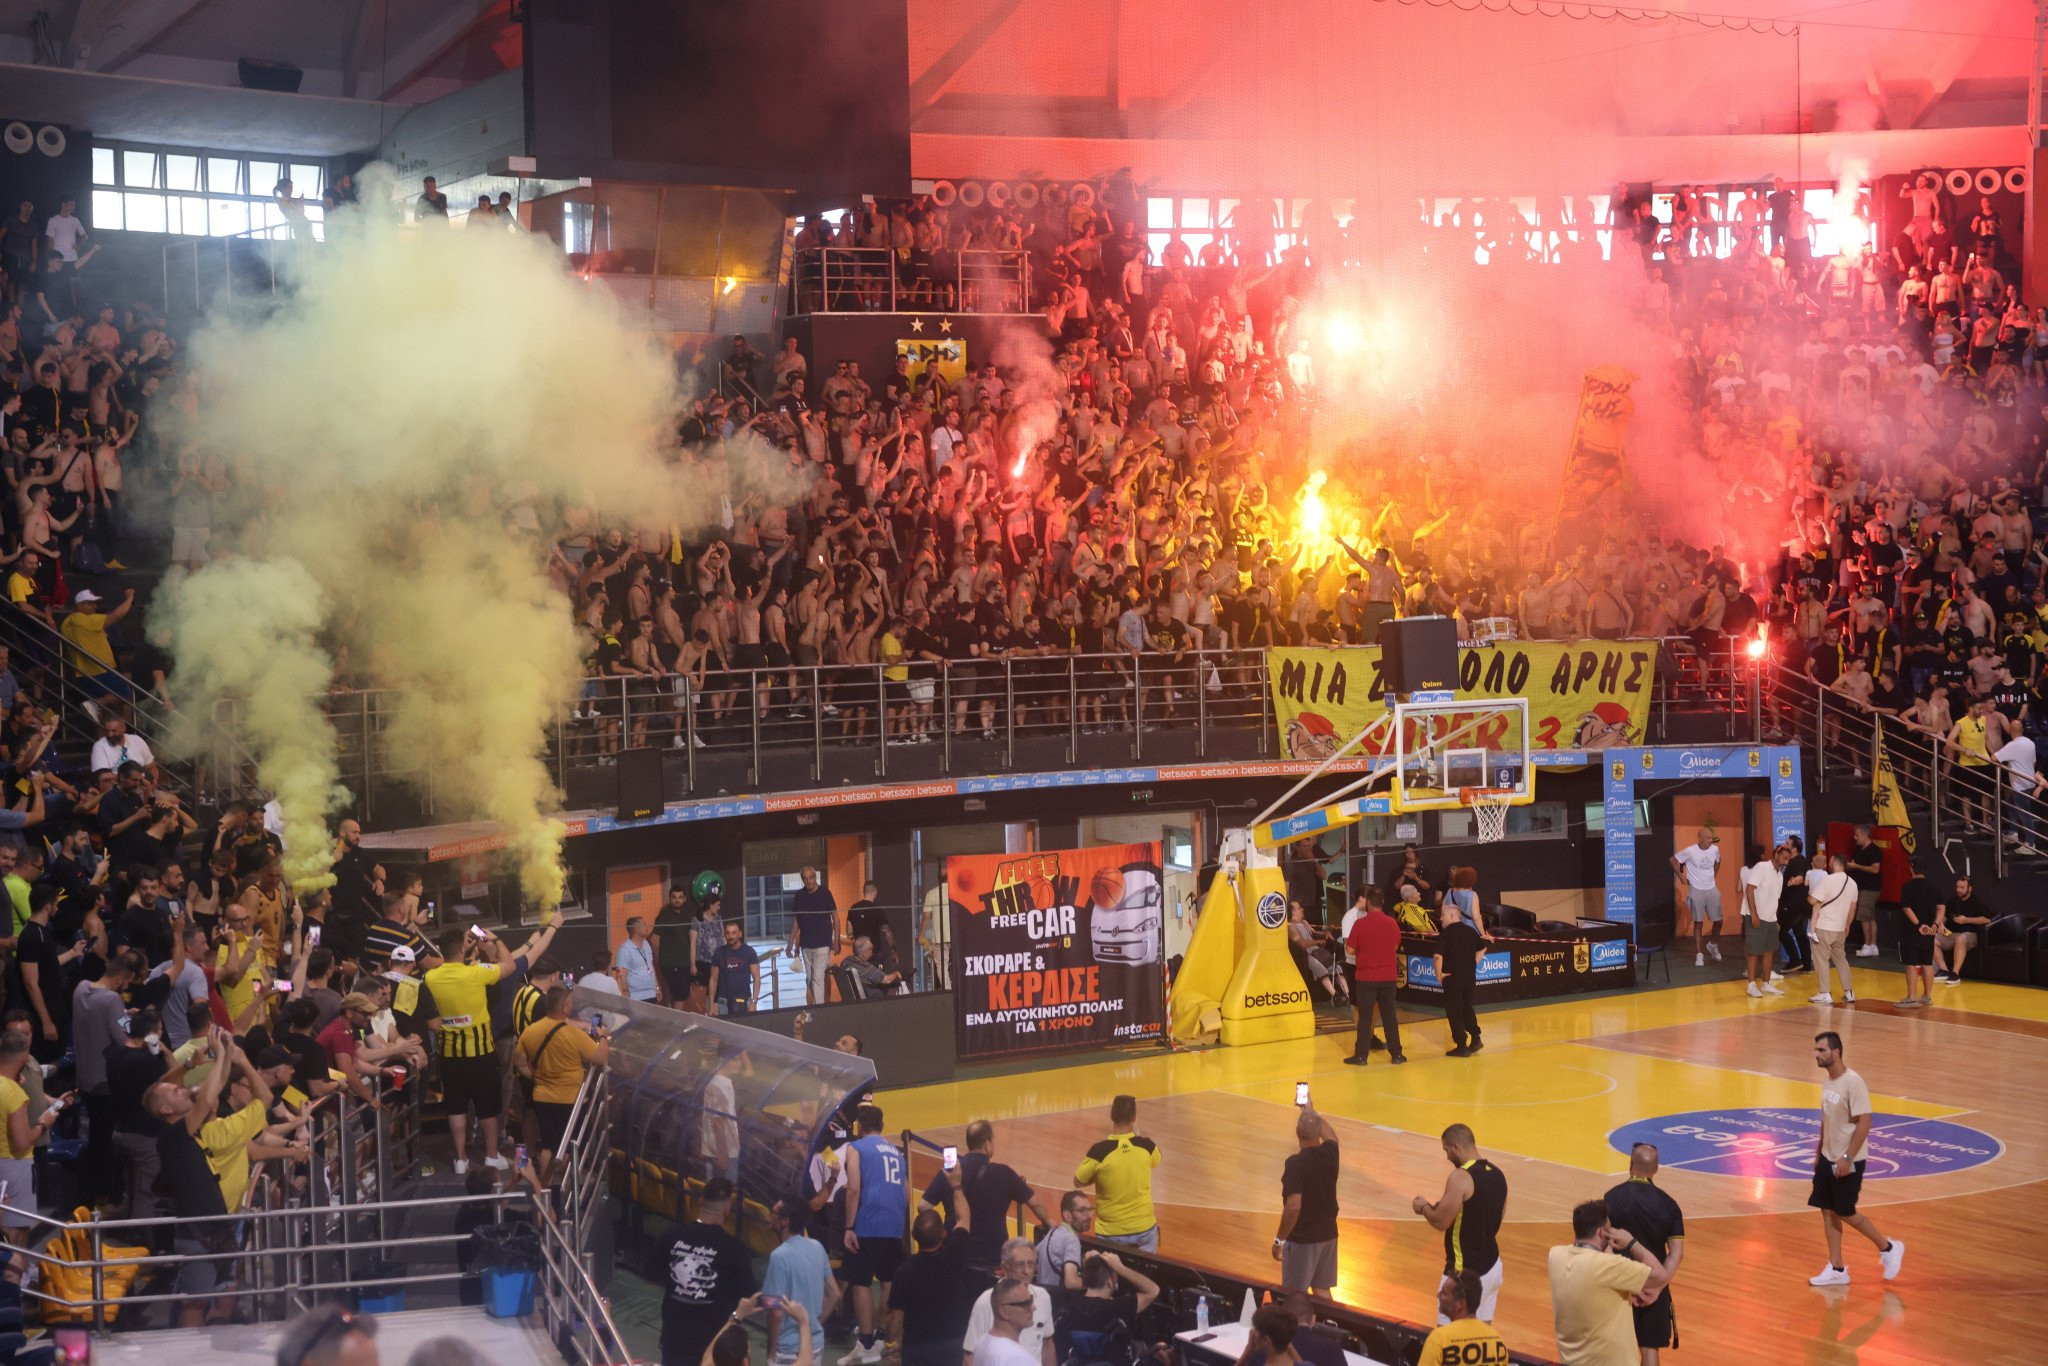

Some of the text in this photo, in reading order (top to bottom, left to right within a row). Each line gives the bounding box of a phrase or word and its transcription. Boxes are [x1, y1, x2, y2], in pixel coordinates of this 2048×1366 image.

[1280, 658, 1346, 705] ΜΙΑ
[1550, 651, 1648, 696] ΑΡΗΣ
[1683, 754, 1720, 767] Midea
[1160, 768, 1197, 779] betsson
[1201, 767, 1238, 777] betsson
[1242, 764, 1279, 775] betsson
[766, 784, 952, 809] betsson betsson betsson betsson betsson
[430, 847, 459, 858] betsson
[1000, 855, 1059, 884] FREE
[990, 905, 1076, 940] FREE CAR
[1520, 952, 1565, 963] HOSPITALITY
[1596, 946, 1625, 959] Midea
[965, 952, 1046, 977] ΣΚΟΡΑΡΕ &
[1413, 962, 1436, 976] Mide
[1480, 959, 1508, 971] Midea
[1521, 964, 1565, 977] AREA
[988, 965, 1099, 1011] ΚΕΡΔΙΣΕ
[1244, 990, 1308, 1008] betsson
[966, 999, 1124, 1027] ΕΝΑ ΑΥΤΟΚΙΝΗΤΟ ΠΟΛΗΣ
[1016, 1016, 1094, 1034] ΓΙΑ 1 ΧΡΟΝΟ
[1113, 1023, 1161, 1036] instacar
[883, 1156, 901, 1184] 12
[1441, 1341, 1507, 1366] BOLD
